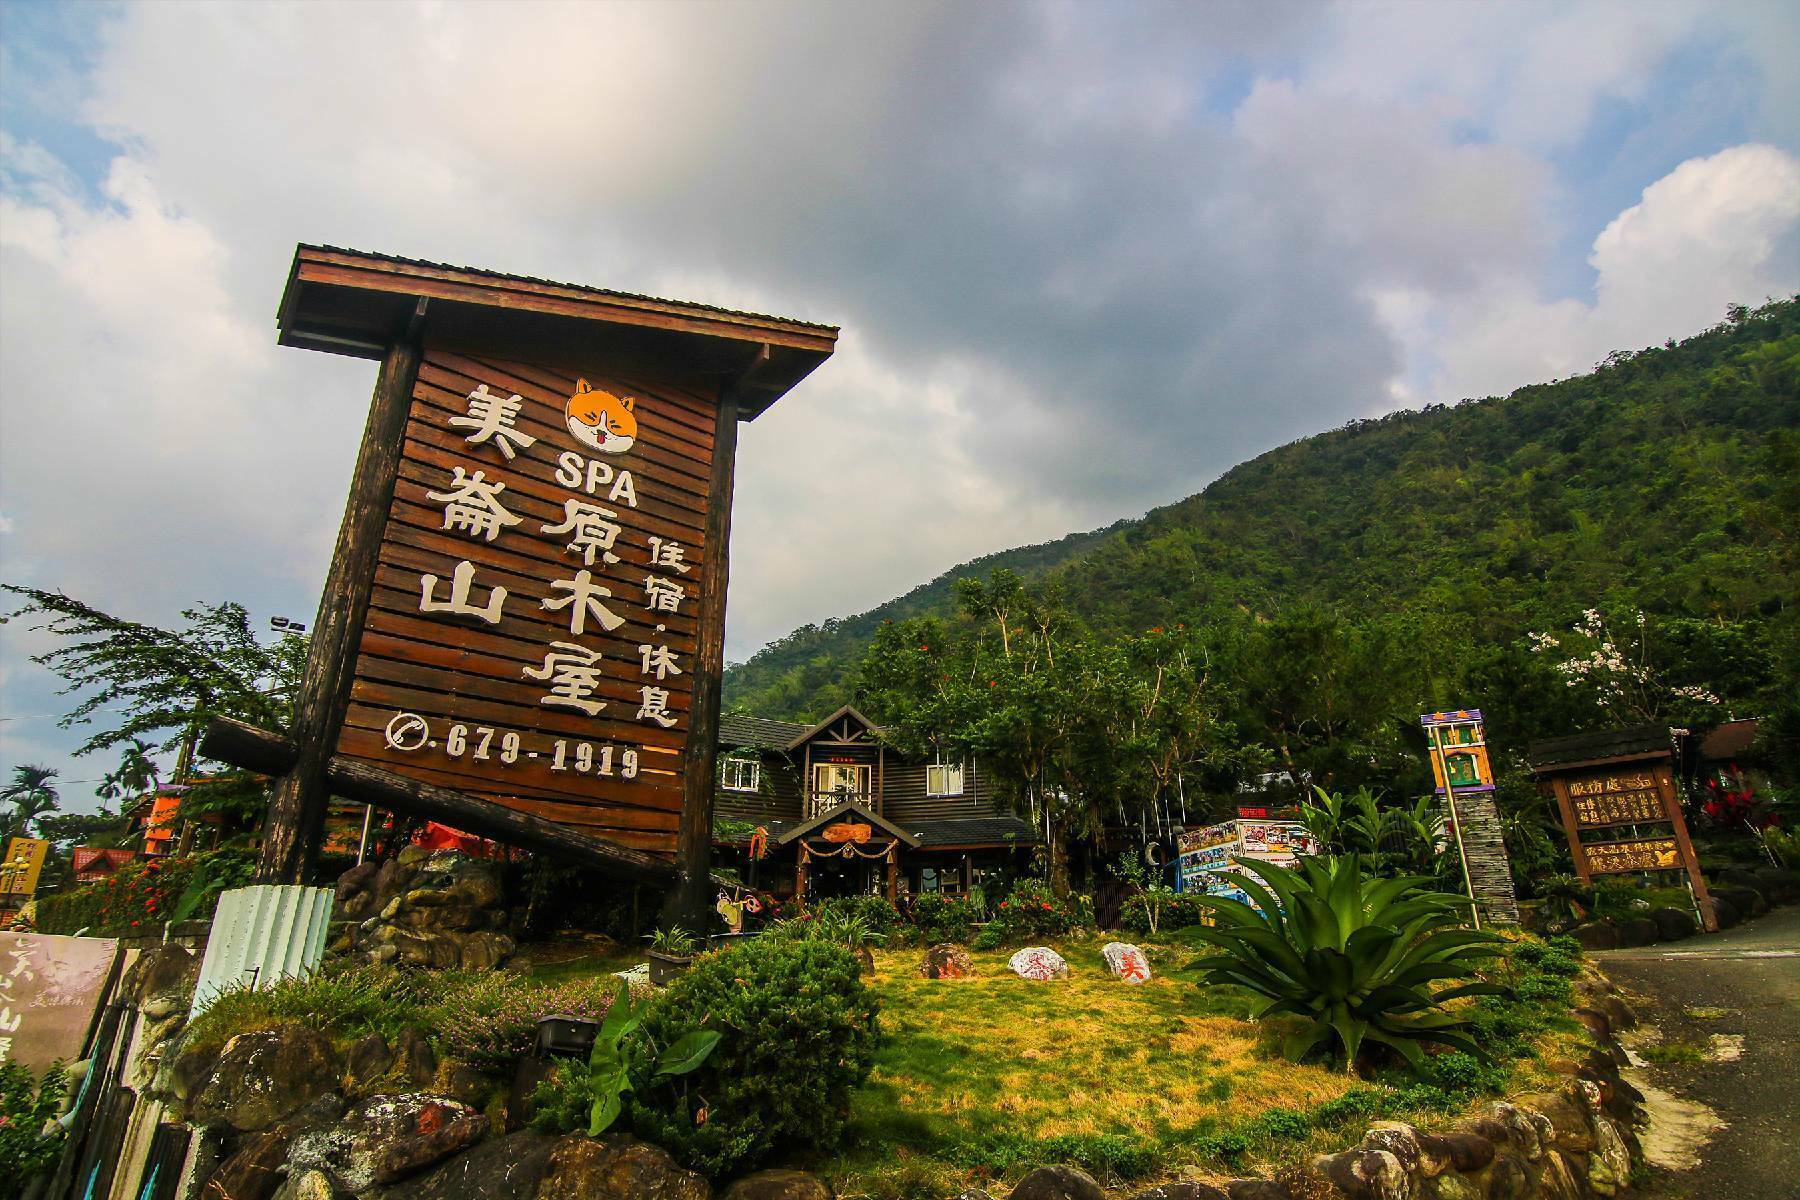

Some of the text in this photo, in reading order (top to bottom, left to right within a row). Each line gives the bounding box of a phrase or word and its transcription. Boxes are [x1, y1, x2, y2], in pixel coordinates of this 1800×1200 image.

[420, 385, 537, 625] 美崙山
[555, 452, 638, 508] SPA
[522, 499, 626, 716] 原木屋
[446, 724, 638, 779] 679-1919
[1119, 951, 1146, 980] 美
